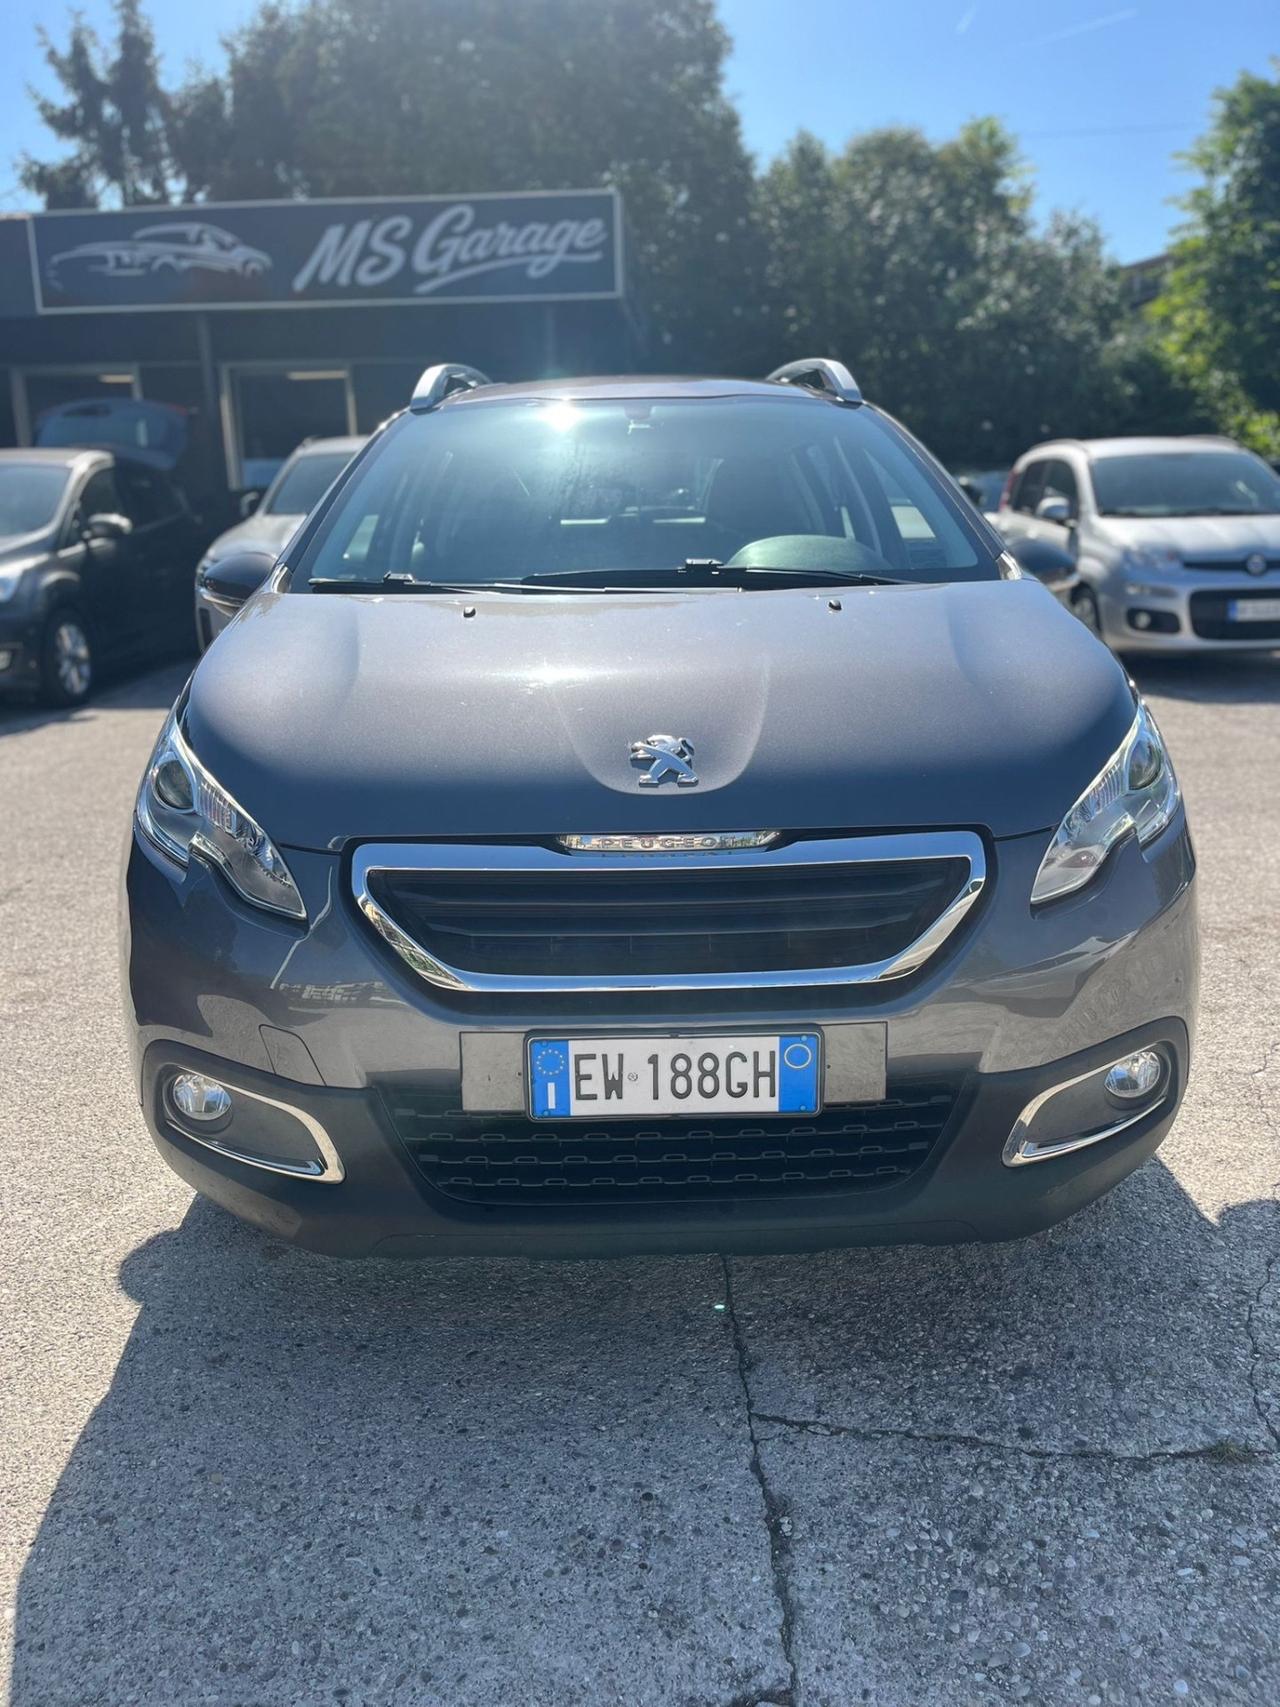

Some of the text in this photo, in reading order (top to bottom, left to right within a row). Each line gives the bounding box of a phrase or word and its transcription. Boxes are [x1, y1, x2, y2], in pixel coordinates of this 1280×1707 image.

[293, 204, 608, 294] MS Garage
[574, 1051, 776, 1100] EW 188GH
